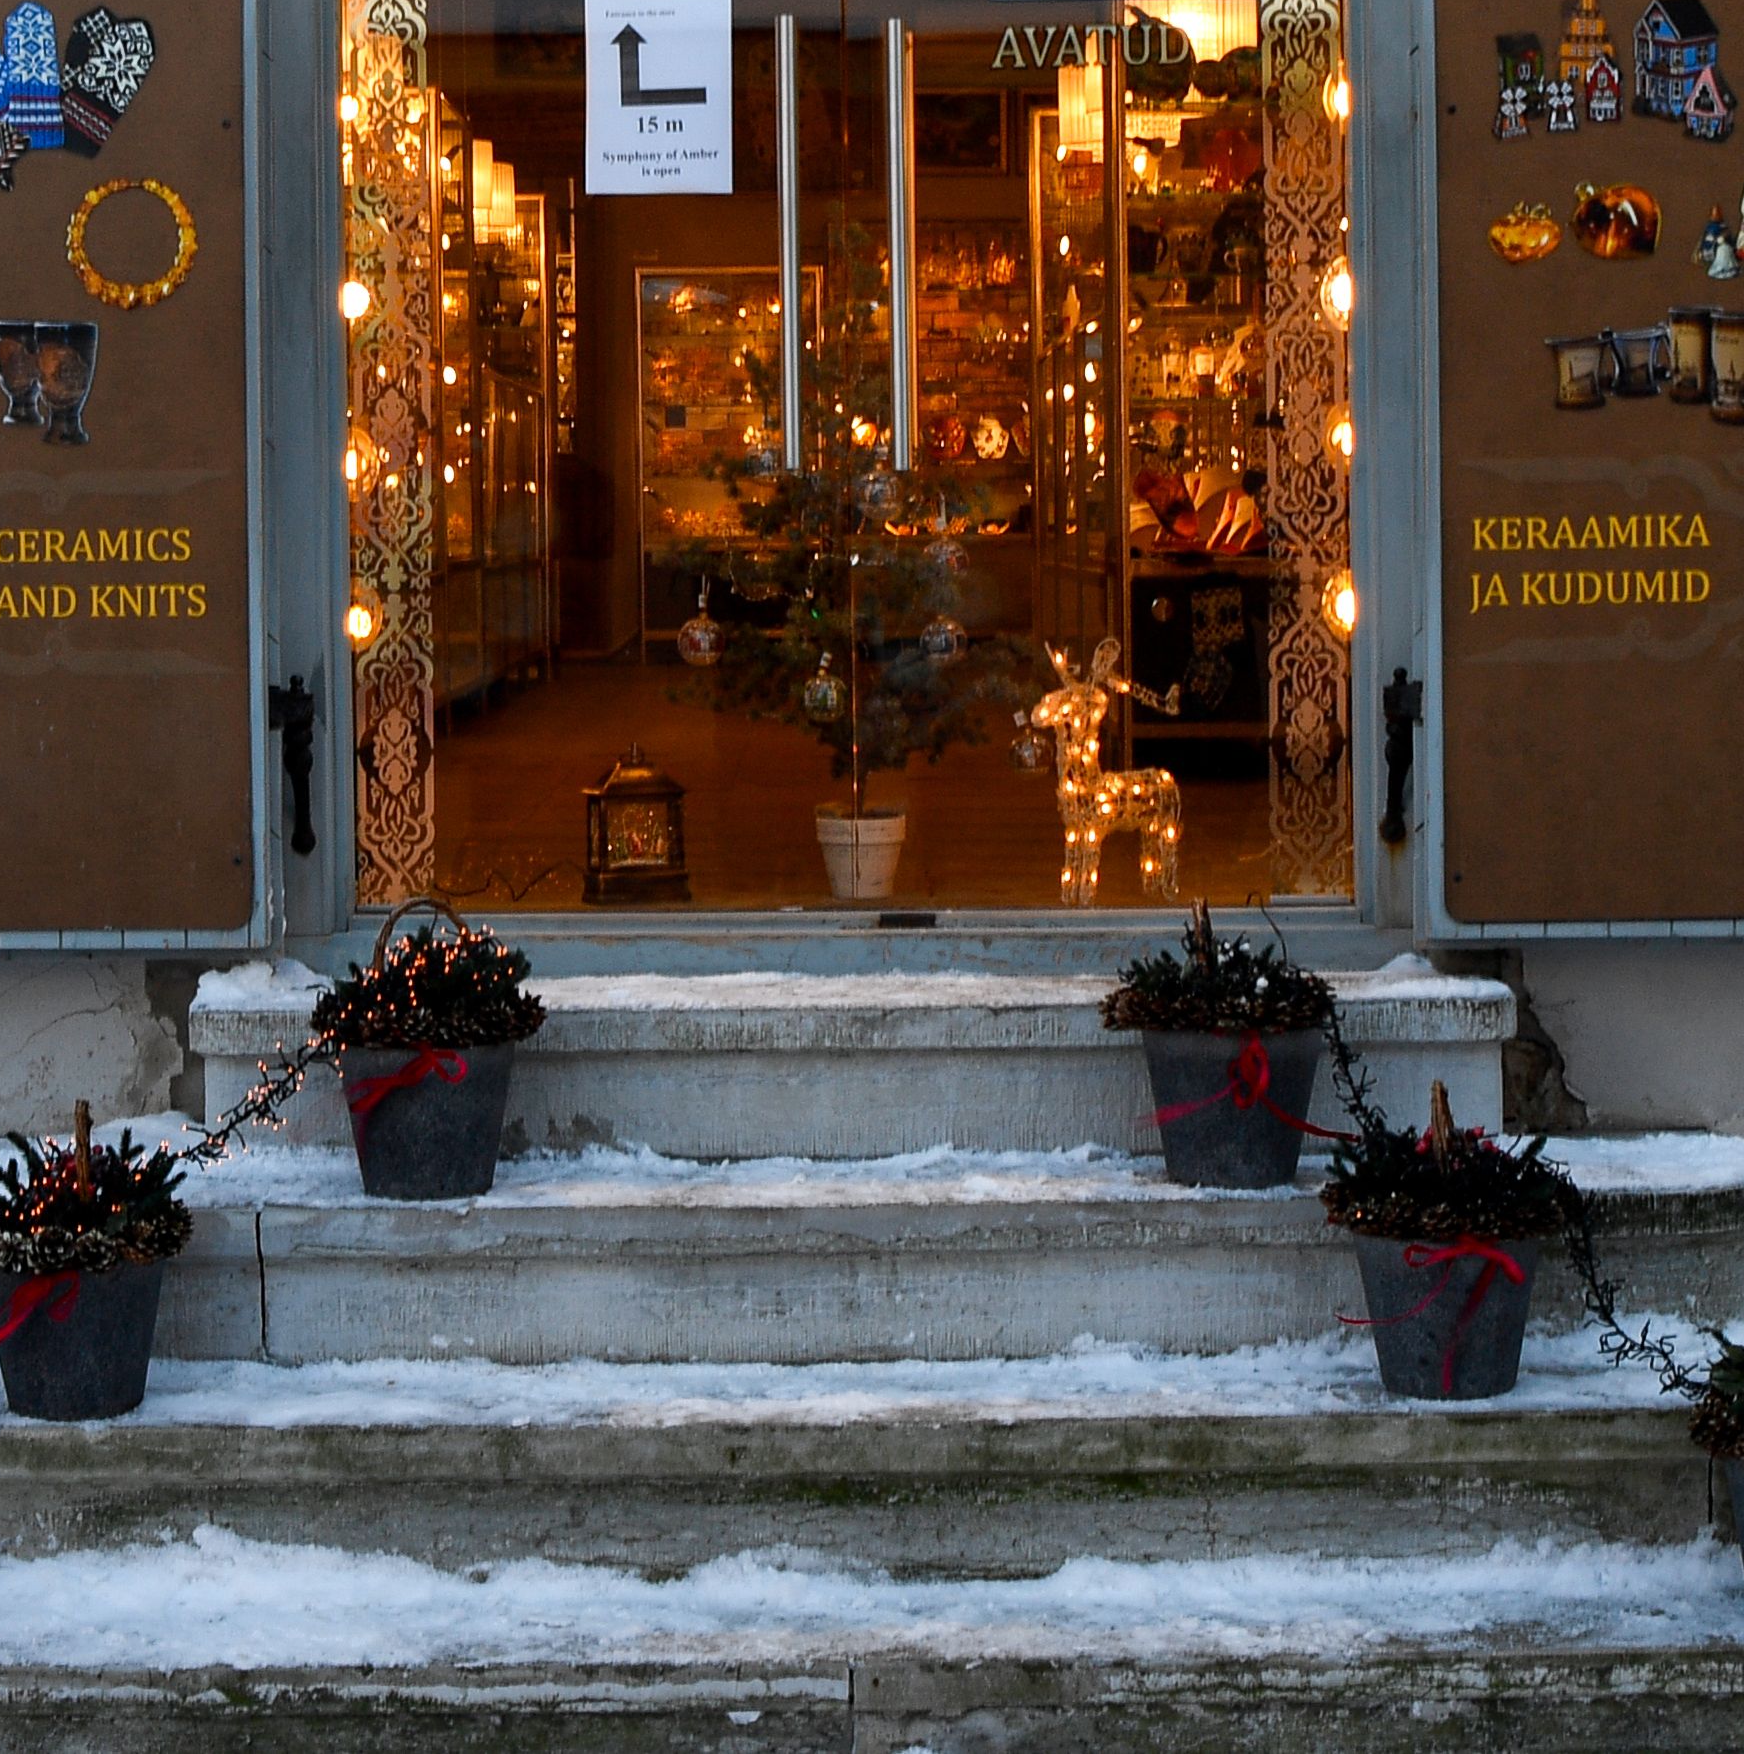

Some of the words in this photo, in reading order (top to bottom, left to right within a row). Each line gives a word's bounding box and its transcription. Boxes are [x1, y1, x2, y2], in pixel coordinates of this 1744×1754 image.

[991, 23, 1190, 70] AVATUD
[637, 116, 659, 134] 15
[665, 118, 684, 134] m
[602, 150, 663, 166] Symphony
[666, 149, 678, 161] of
[680, 148, 719, 161] Amber
[642, 165, 651, 177] is
[653, 167, 681, 179] open
[1472, 512, 1711, 552] KERAAMIKA
[89, 583, 208, 618] KNITS
[1469, 572, 1510, 614] JA
[1520, 568, 1711, 606] KUDUMID
